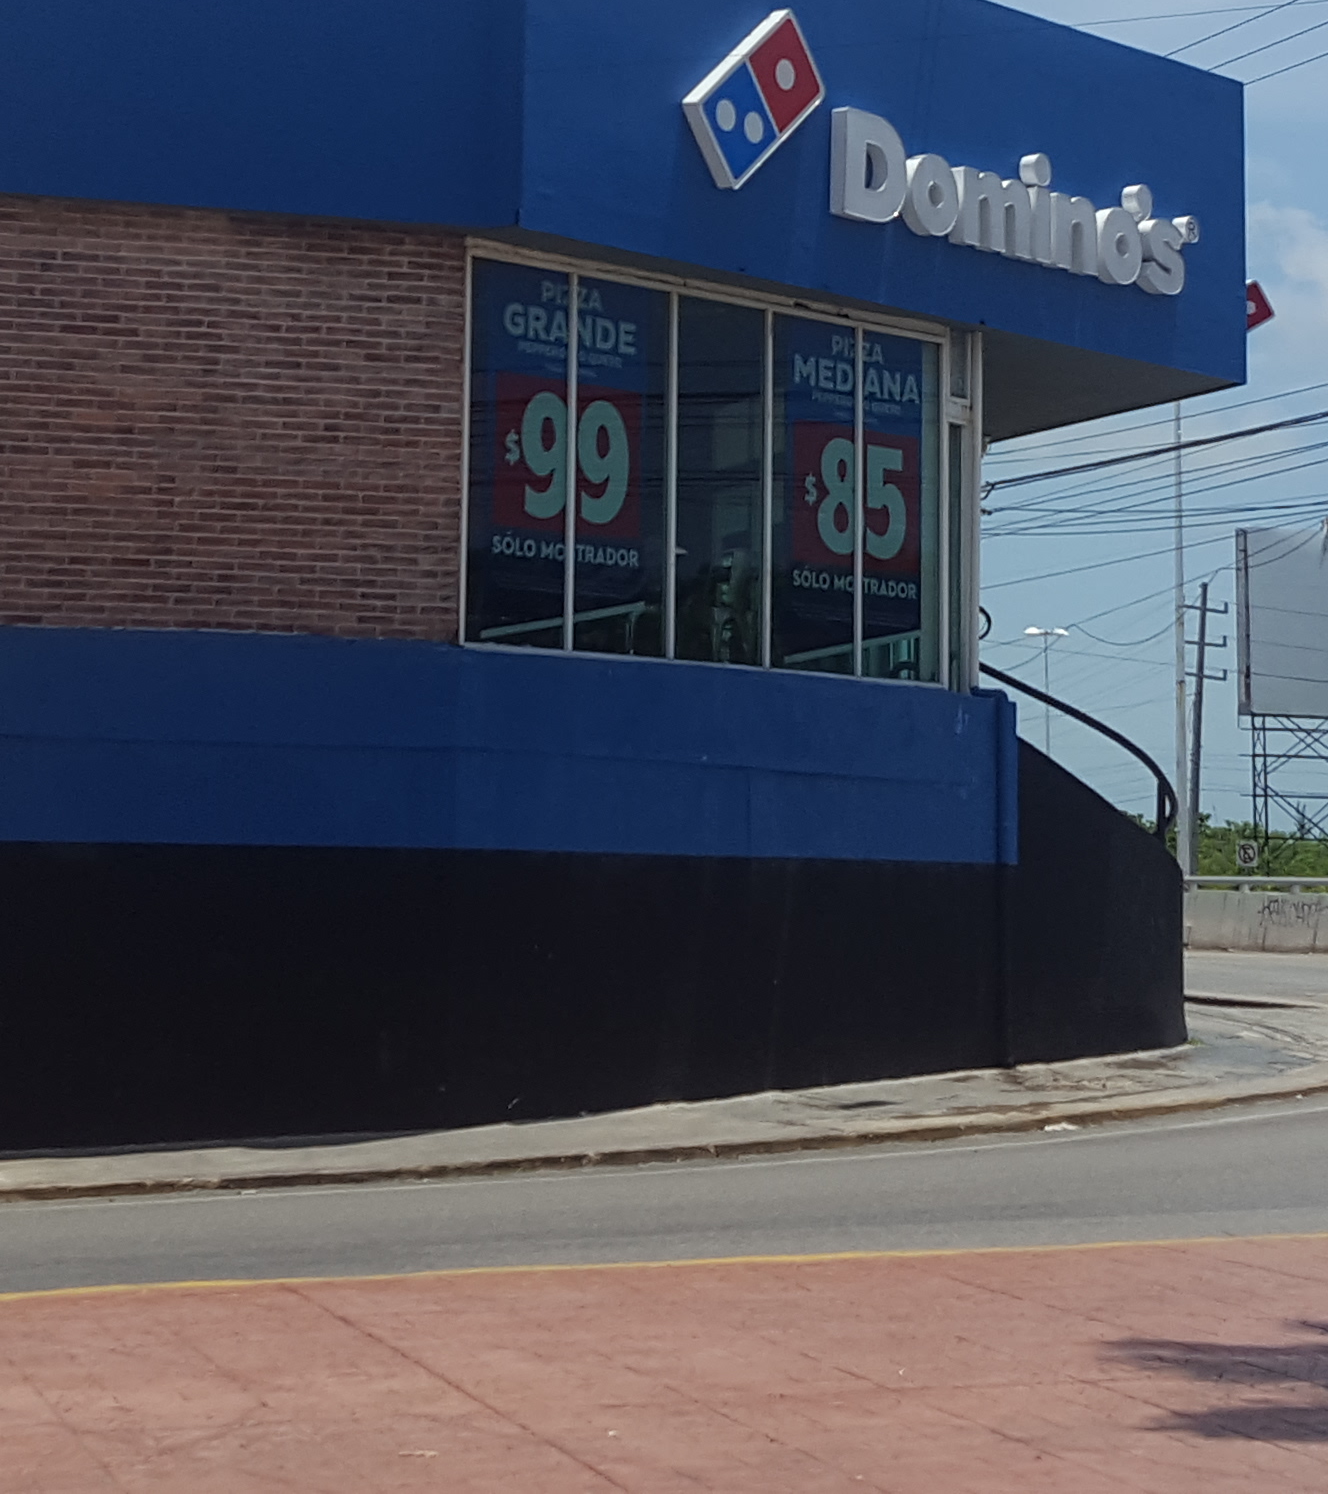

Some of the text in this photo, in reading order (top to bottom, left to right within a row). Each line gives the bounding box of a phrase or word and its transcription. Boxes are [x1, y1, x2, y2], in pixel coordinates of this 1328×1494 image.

[829, 105, 1186, 295] Domino's
[503, 302, 637, 355] GRANDE
[793, 354, 920, 404] MEDANA
[492, 530, 639, 568] SÓLO MOTRADOR
[792, 566, 917, 600] SÓLO MOTRADOR
